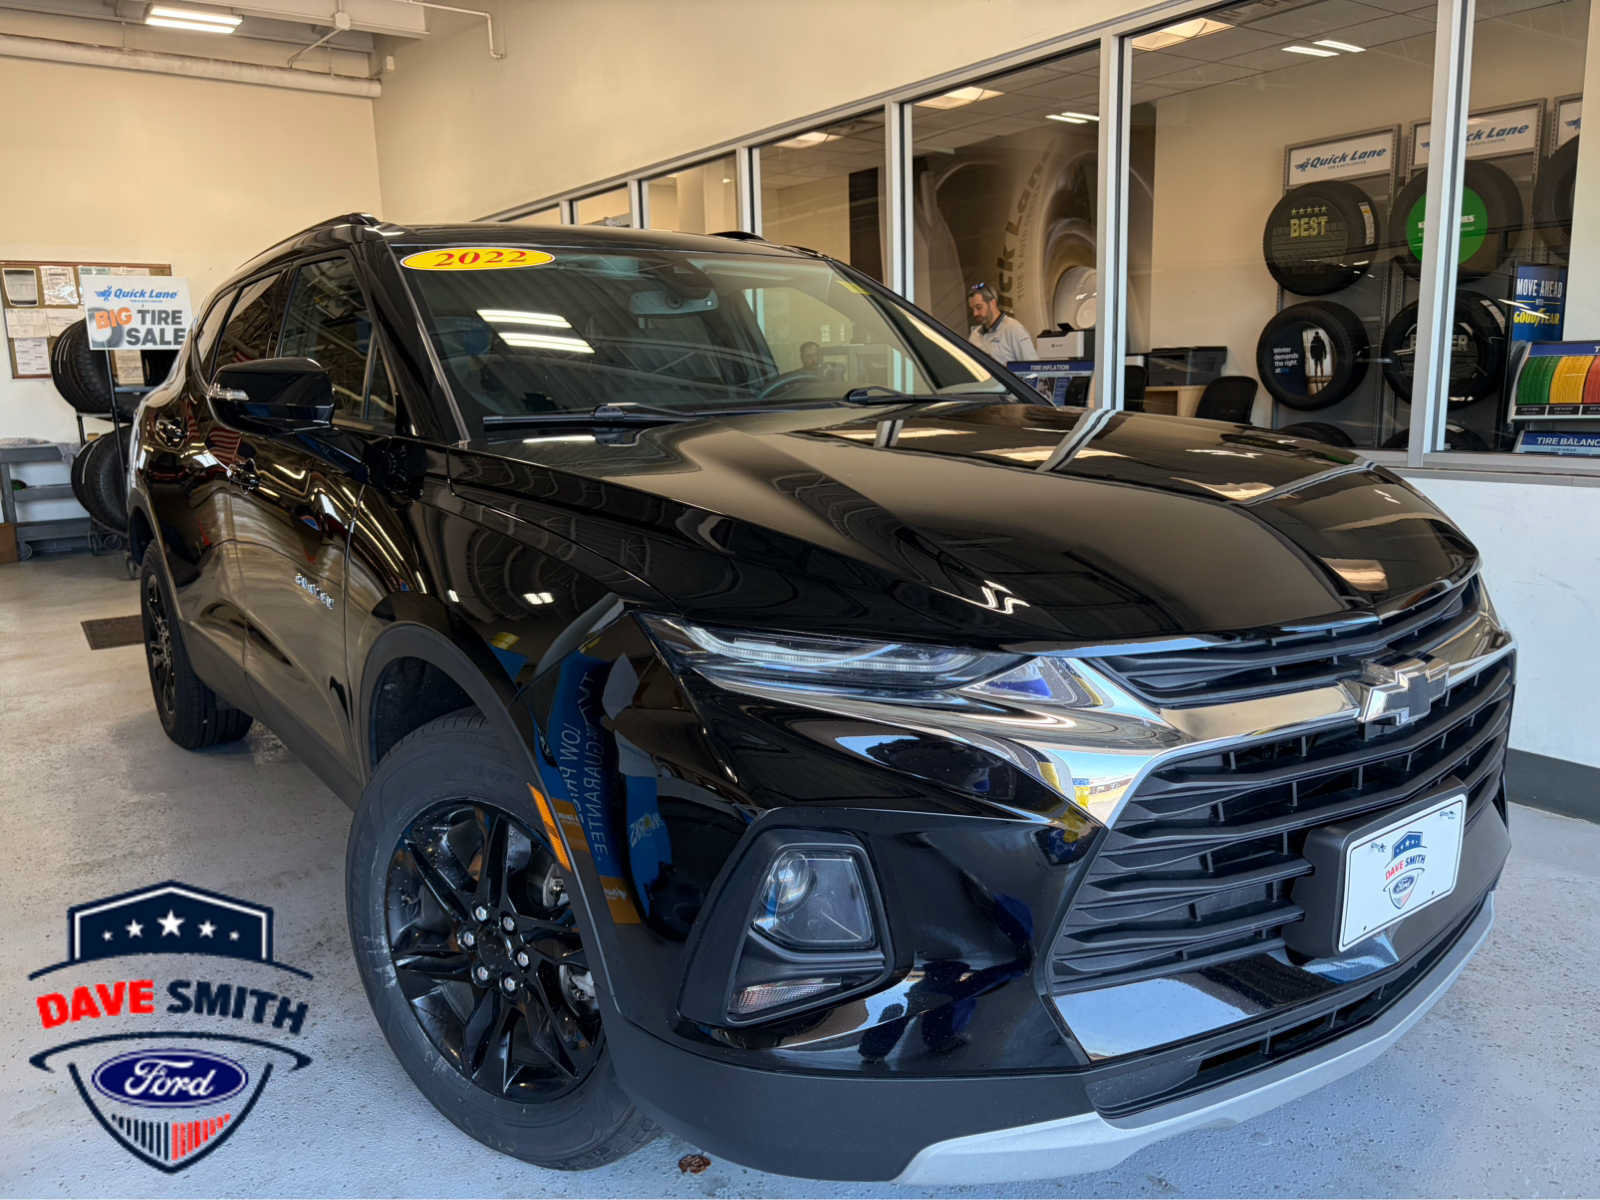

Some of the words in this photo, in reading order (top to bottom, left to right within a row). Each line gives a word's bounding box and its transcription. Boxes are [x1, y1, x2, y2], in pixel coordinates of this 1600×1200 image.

[1486, 124, 1530, 139] Lane
[1311, 152, 1347, 169] Quick
[1350, 148, 1387, 161] Lane
[1290, 216, 1329, 239] BEST
[433, 250, 528, 267] 2022
[114, 287, 148, 299] Quick
[149, 288, 178, 299] Lane
[1516, 278, 1538, 296] MOVE
[1540, 280, 1563, 297] AHEAD
[95, 307, 133, 330] BIG
[137, 309, 183, 325] TIRE
[126, 327, 187, 346] SALE
[1536, 437, 1559, 445] TIRE
[1385, 860, 1405, 880] DAVE
[1405, 854, 1426, 867] SMITH
